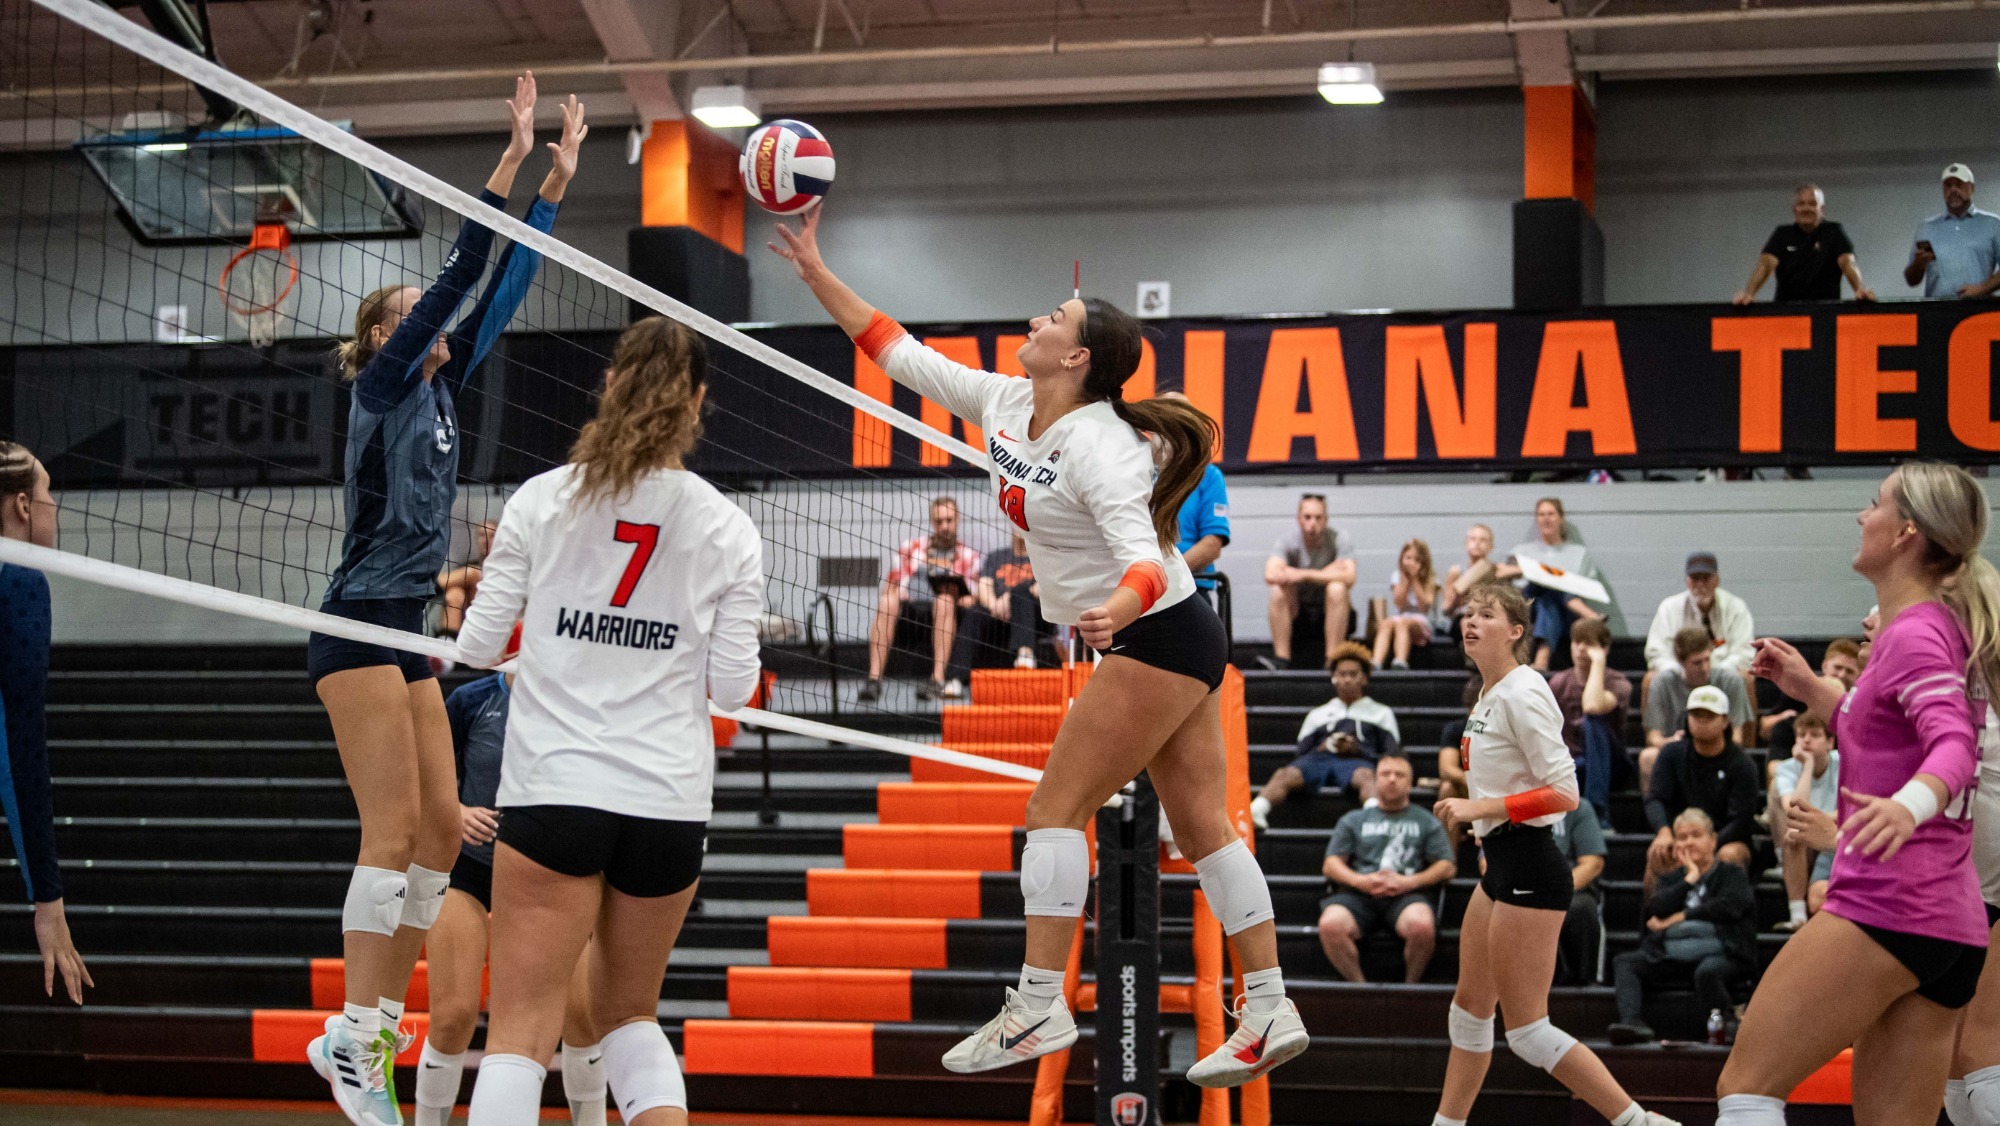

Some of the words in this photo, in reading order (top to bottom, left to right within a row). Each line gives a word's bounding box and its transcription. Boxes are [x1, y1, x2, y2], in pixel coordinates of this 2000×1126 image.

[759, 136, 776, 192] molten
[151, 390, 310, 445] TECH
[853, 319, 1638, 468] INIANA
[998, 474, 1030, 532] 18
[1028, 465, 1058, 487] CH
[609, 519, 661, 608] 7
[556, 606, 679, 650] WARRIORS
[1119, 965, 1137, 1017] sports
[1119, 1018, 1137, 1083] imports
